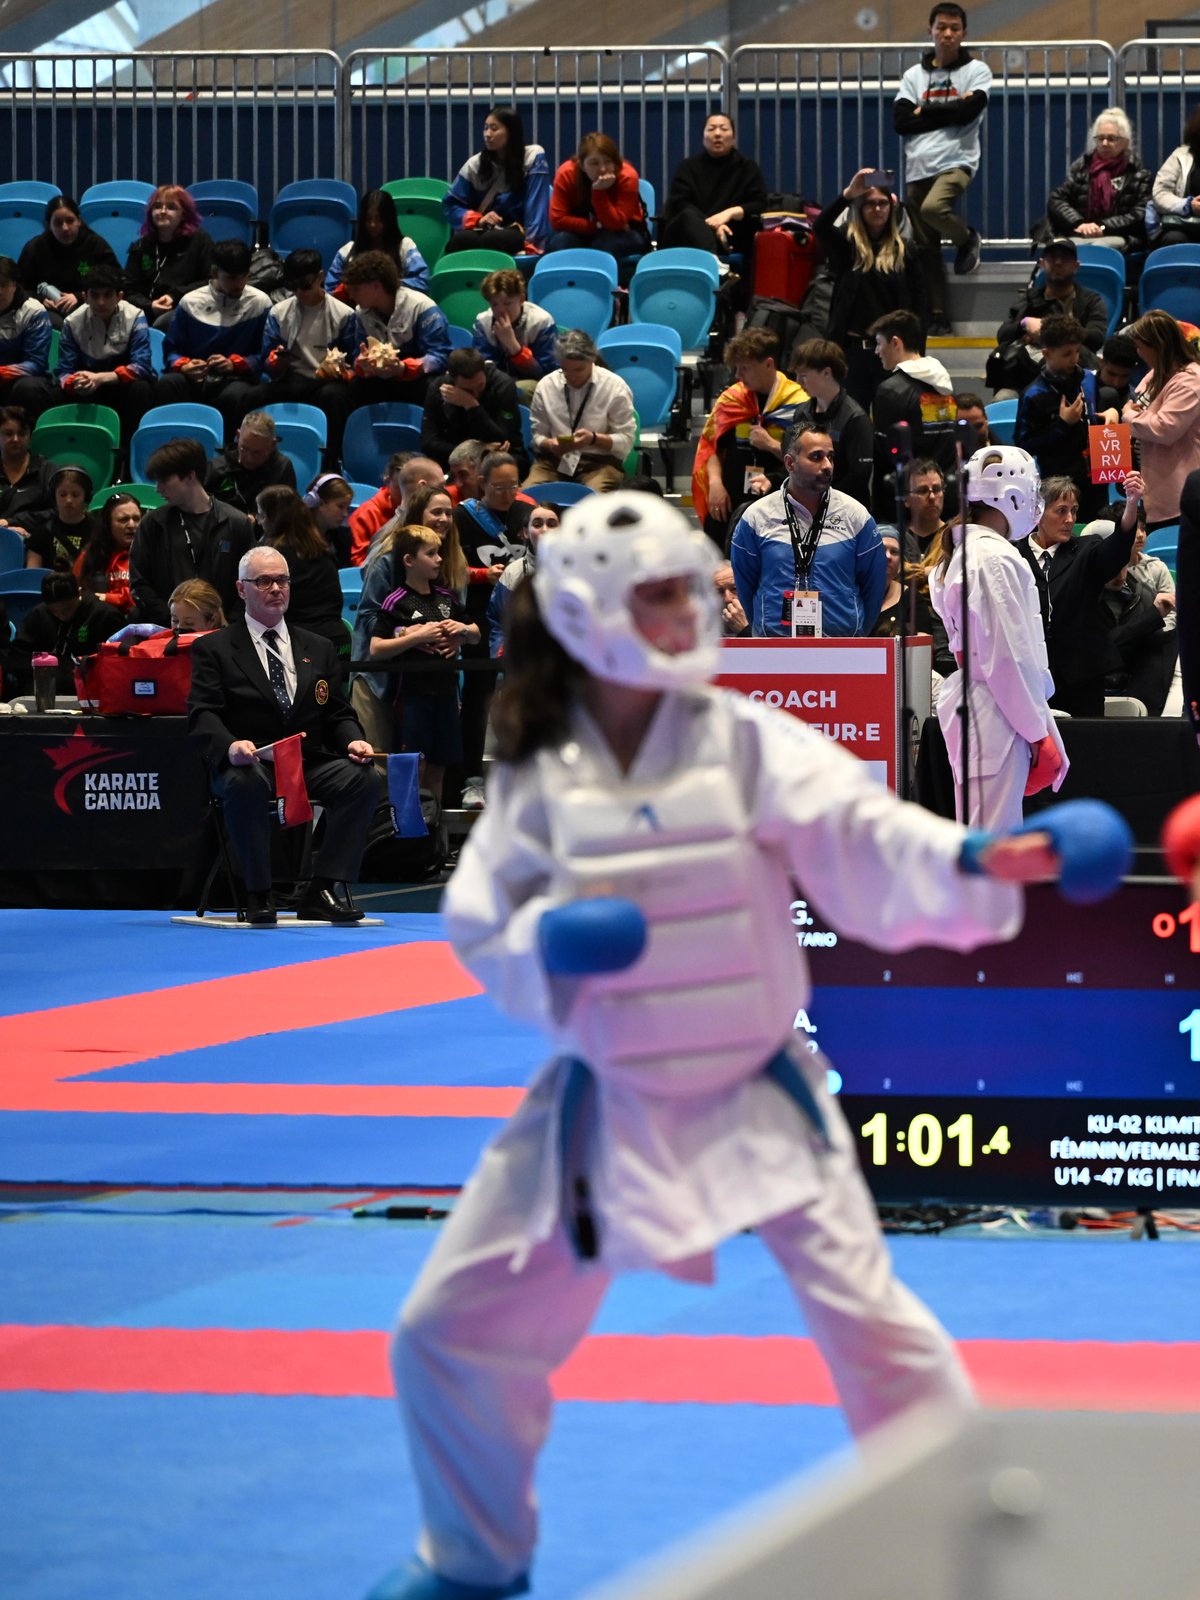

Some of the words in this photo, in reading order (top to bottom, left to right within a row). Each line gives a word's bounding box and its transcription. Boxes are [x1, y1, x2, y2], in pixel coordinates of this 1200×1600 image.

[1100, 440, 1121, 452] VR
[1101, 454, 1121, 467] RV
[1098, 469, 1127, 482] AKA
[749, 690, 837, 709] COACH
[84, 772, 159, 791] KARATE
[84, 792, 161, 810] CANADA
[795, 932, 838, 947] TARIO
[1087, 1114, 1143, 1134] KU-02
[1050, 1136, 1200, 1162] FÉMININ/FEMALE
[1054, 1166, 1091, 1186] U14
[1093, 1167, 1124, 1186] -47
[1127, 1167, 1154, 1187] KG
